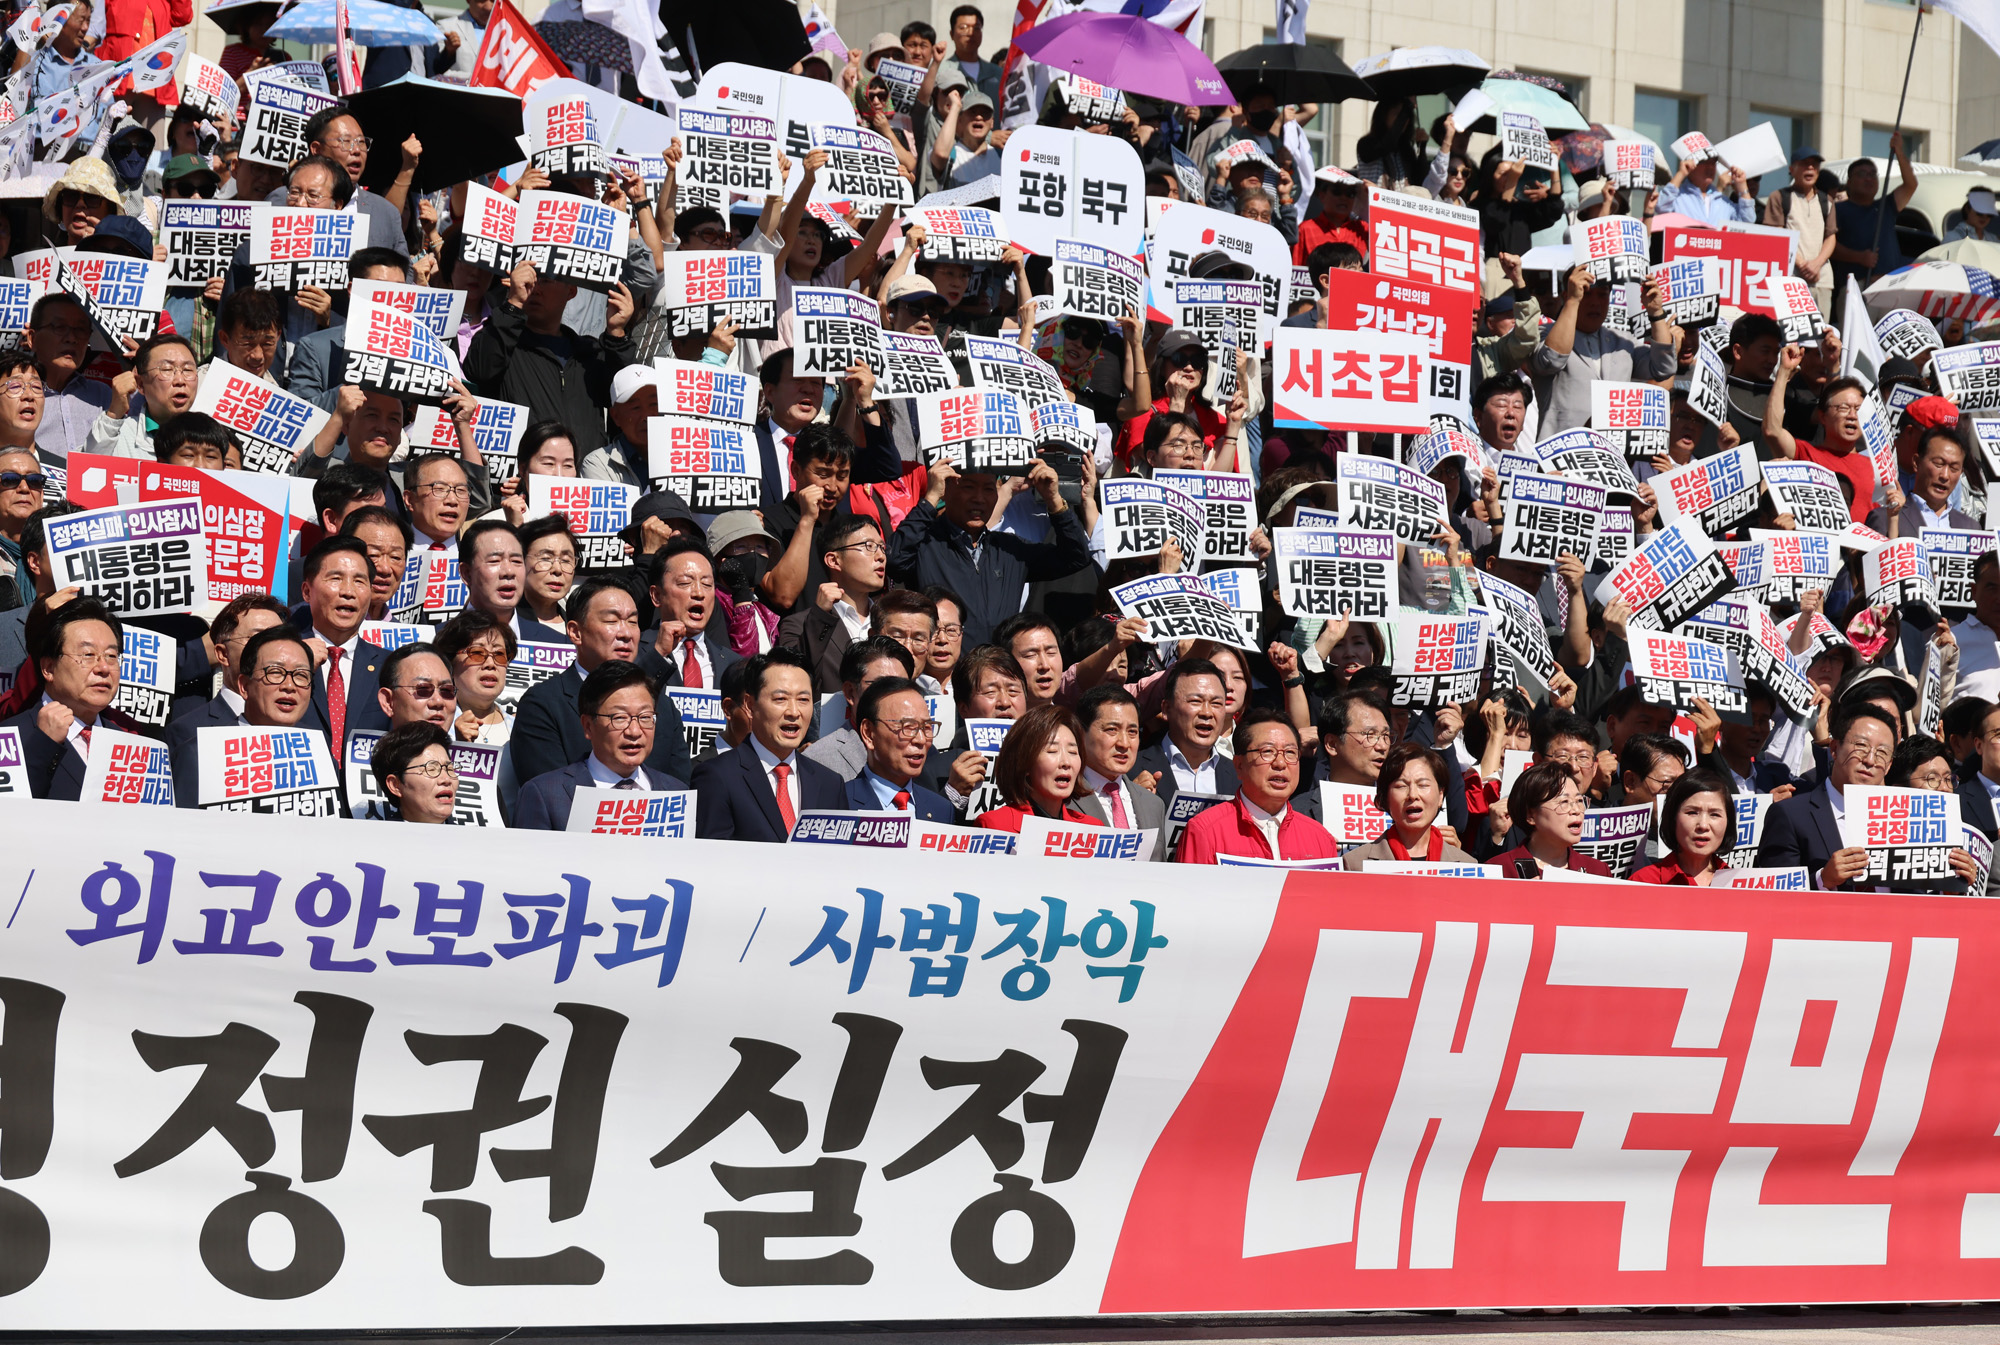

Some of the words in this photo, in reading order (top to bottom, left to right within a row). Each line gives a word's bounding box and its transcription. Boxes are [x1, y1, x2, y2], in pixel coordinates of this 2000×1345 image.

[732, 89, 764, 106] 국민의힘
[680, 110, 777, 141] 정책실패·인사참사
[686, 135, 773, 164] 대통령은
[824, 148, 902, 177] 대통령은
[1032, 152, 1061, 166] 국민의힘
[685, 160, 773, 191] 사죄하라
[828, 172, 904, 201] 사죄하라
[483, 197, 516, 222] 민생
[1018, 170, 1067, 218] 포항
[1082, 177, 1128, 226] 북구
[272, 214, 354, 238] 민생파탄
[536, 200, 616, 227] 민생파탄
[480, 217, 515, 243] 헌정
[532, 221, 612, 252] 헌정파괴
[931, 220, 996, 239] 헌정파괴
[1217, 234, 1253, 255] 국민의힘
[1689, 235, 1723, 250] 국민의힘
[270, 235, 351, 260] 헌정파괴
[463, 236, 498, 267] 강력
[1056, 239, 1142, 284] 정책실패·인사참사
[1374, 221, 1476, 292] 칠곡군
[255, 262, 291, 291] 강력
[553, 247, 622, 283] 규탄한다
[685, 255, 762, 282] 민생파탄
[1063, 264, 1140, 294] 대통령은
[685, 277, 761, 304] 헌정파괴
[1176, 283, 1262, 305] 정책실패·인사참사
[1392, 284, 1431, 305] 국민의힘
[671, 307, 709, 337] 강력
[797, 292, 880, 325] 정책실패·인사참사
[366, 330, 449, 369] 헌정파괴
[804, 319, 882, 352] 대통령은
[344, 352, 388, 387] 강력
[676, 368, 747, 394] 민생파탄
[1281, 347, 1422, 404] 서초갑
[223, 377, 313, 425] 민생파탄
[676, 393, 744, 420] 헌정파괴
[940, 393, 1018, 421] 민생파탄
[1609, 389, 1666, 408] 민생파탄
[212, 397, 302, 449] 헌정파괴
[940, 414, 1021, 442] 헌정파괴
[1608, 407, 1666, 428] 헌정파괴
[671, 426, 743, 452] 민생파탄
[972, 440, 1037, 466] 규탄한다
[670, 450, 746, 475] 헌정파괴
[1670, 450, 1741, 499] 민생파탄
[163, 478, 200, 494] 국민의힘
[698, 477, 761, 508] 규탄한다
[1342, 460, 1443, 505] 정책실패·인사참사
[1514, 478, 1604, 513] 정책실패·인사참사
[550, 485, 627, 511] 민생파탄
[1105, 485, 1204, 528] 정책실패·인사참사
[1349, 481, 1440, 518] 대통령은
[1703, 484, 1760, 535] 규탄한다
[1779, 485, 1844, 511] 대통령은
[51, 508, 199, 548] 정책실패·인사참사
[1114, 504, 1199, 551] 대통령은
[1514, 504, 1596, 540] 대통령은
[1280, 532, 1393, 558] 정책실패·인사참사
[1611, 524, 1684, 595] 민생파탄
[1773, 536, 1829, 558] 민생파탄
[64, 539, 192, 583] 대통령은
[1289, 559, 1387, 588] 대통령은
[1773, 556, 1830, 576] 헌정파괴
[1623, 543, 1698, 614] 헌정파괴
[1662, 553, 1728, 622] 규탄한다
[1769, 578, 1801, 603] 강력
[1134, 595, 1240, 626] 대통령은
[1291, 588, 1388, 618] 사죄하라
[1150, 615, 1247, 647] 사죄하라
[1418, 621, 1480, 648] 민생파탄
[1414, 645, 1477, 672] 헌정파괴
[1647, 637, 1724, 664] 민생파탄
[1650, 659, 1728, 683] 헌정파괴
[1391, 676, 1435, 707] 강력
[1641, 678, 1676, 704] 강력
[107, 743, 172, 777] 민생파탄
[223, 731, 313, 768] 민생파탄
[101, 775, 174, 807] 헌정파괴
[223, 759, 320, 798] 헌정파괴
[594, 794, 687, 827] 민생파탄
[1866, 794, 1947, 821] 민생파탄
[796, 818, 910, 845] 정책실패·인사참사
[1043, 830, 1144, 861] 민생파탄
[1866, 820, 1947, 847] 헌정파괴
[65, 850, 694, 989] 외교안보파괴
[789, 886, 1168, 1004] 사법장악
[1242, 921, 1960, 1271] 대국민
[113, 990, 630, 1300] 정권
[650, 1012, 1130, 1292] 실정
